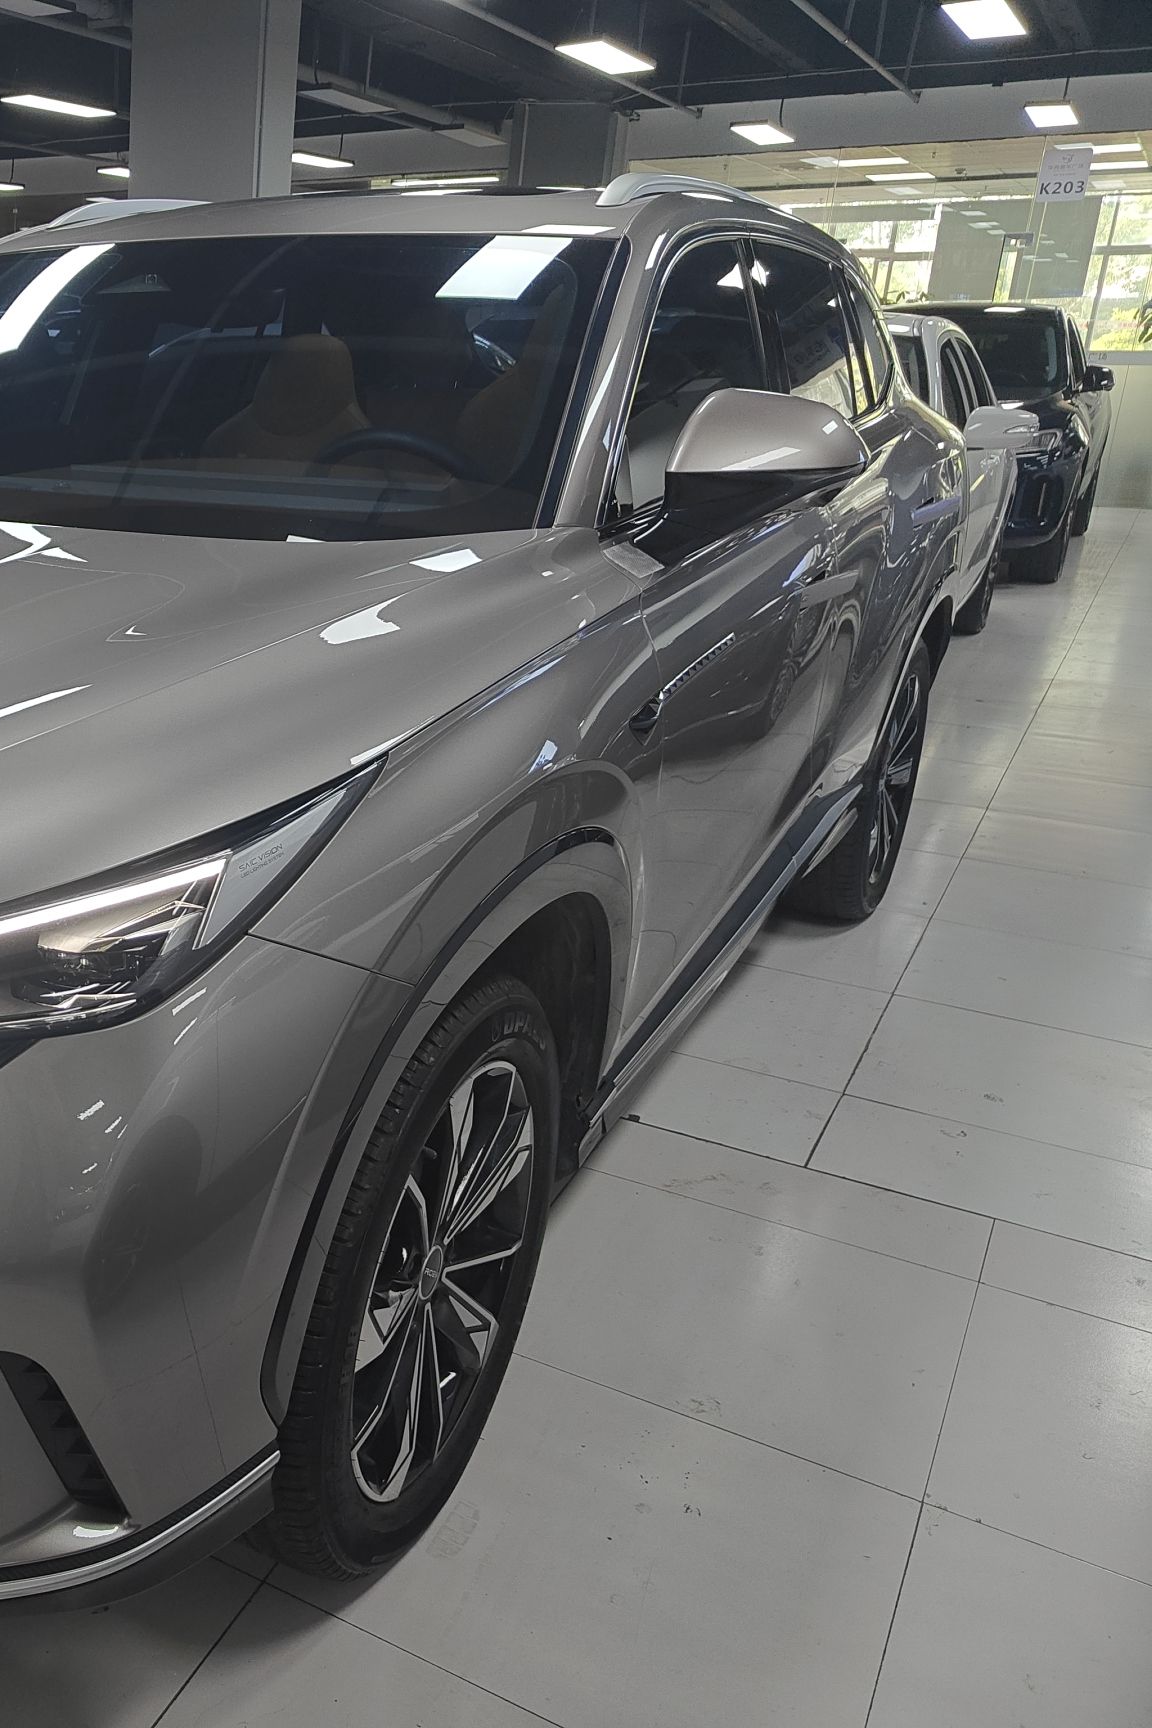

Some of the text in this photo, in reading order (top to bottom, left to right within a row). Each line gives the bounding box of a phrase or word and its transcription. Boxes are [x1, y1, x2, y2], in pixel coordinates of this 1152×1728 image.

[1039, 181, 1085, 195] K203
[238, 843, 283, 872] SAIC VISION
